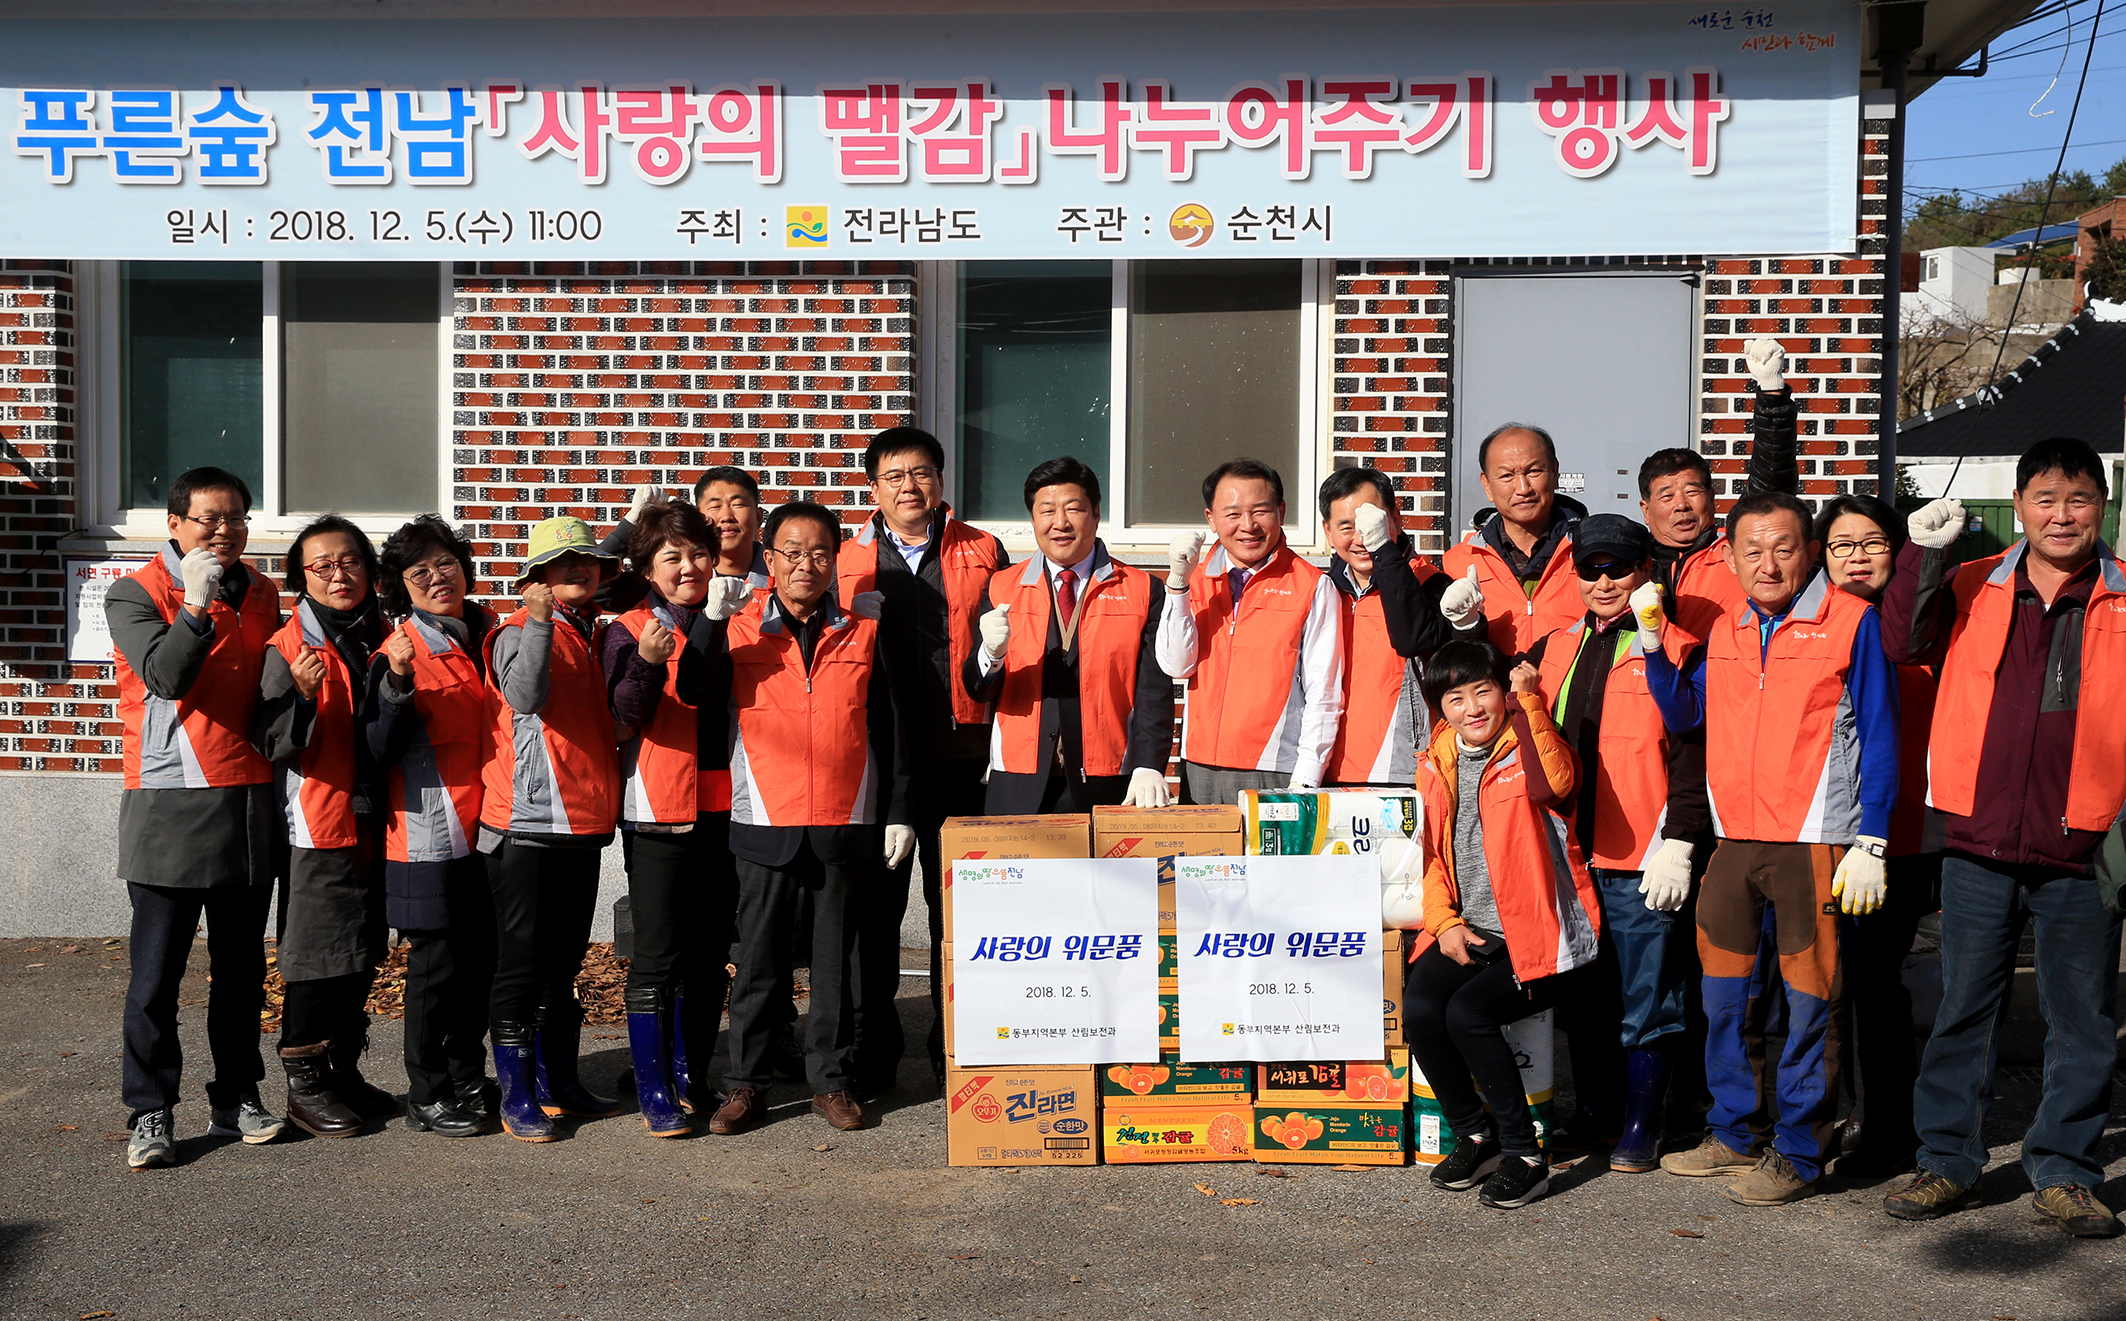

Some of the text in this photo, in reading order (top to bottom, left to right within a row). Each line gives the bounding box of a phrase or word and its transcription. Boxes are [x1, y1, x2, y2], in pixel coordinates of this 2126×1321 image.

[1688, 8, 1774, 30] 새로운 순천
[1741, 31, 1836, 51] 시민과 함께
[15, 85, 270, 179] 푸른숲
[307, 85, 478, 179] 전남
[1533, 72, 1723, 171] 행사
[166, 208, 229, 244] 일시
[269, 210, 355, 242] 2018.
[370, 210, 410, 242] 12.
[425, 209, 515, 245] 5.(수)
[529, 210, 603, 241] 11:00
[676, 208, 743, 244] 주최
[843, 207, 982, 244] 전라남도
[1057, 206, 1128, 243] 주관
[1227, 204, 1333, 242] 순천시
[76, 567, 97, 580] 서면
[969, 936, 1052, 962] 사랑의
[1062, 934, 1144, 961] 위문품
[1193, 932, 1276, 959] 사랑의
[1285, 931, 1368, 958] 위문품
[1026, 986, 1092, 999] 2018. 12. 5.
[1249, 982, 1315, 995] 2018. 12. 5.
[1012, 1026, 1117, 1039] 동부지역본부 산림보전과
[1237, 1023, 1341, 1035] 동부지역본부 산림보전과
[1218, 1067, 1245, 1079] 감귤
[1270, 1062, 1342, 1088] 서귀포 감귤
[957, 1080, 981, 1103] 멀티팩
[976, 1107, 998, 1117] 오뚜기
[1005, 1089, 1077, 1123] 진라면
[1056, 1120, 1086, 1132] 순한맛
[1150, 1116, 1198, 1124] MANDARIN
[1116, 1126, 1150, 1144] 청정
[1162, 1130, 1195, 1144] 감귤
[1373, 1125, 1399, 1137] 감귤
[1231, 1146, 1249, 1156] 5kg
